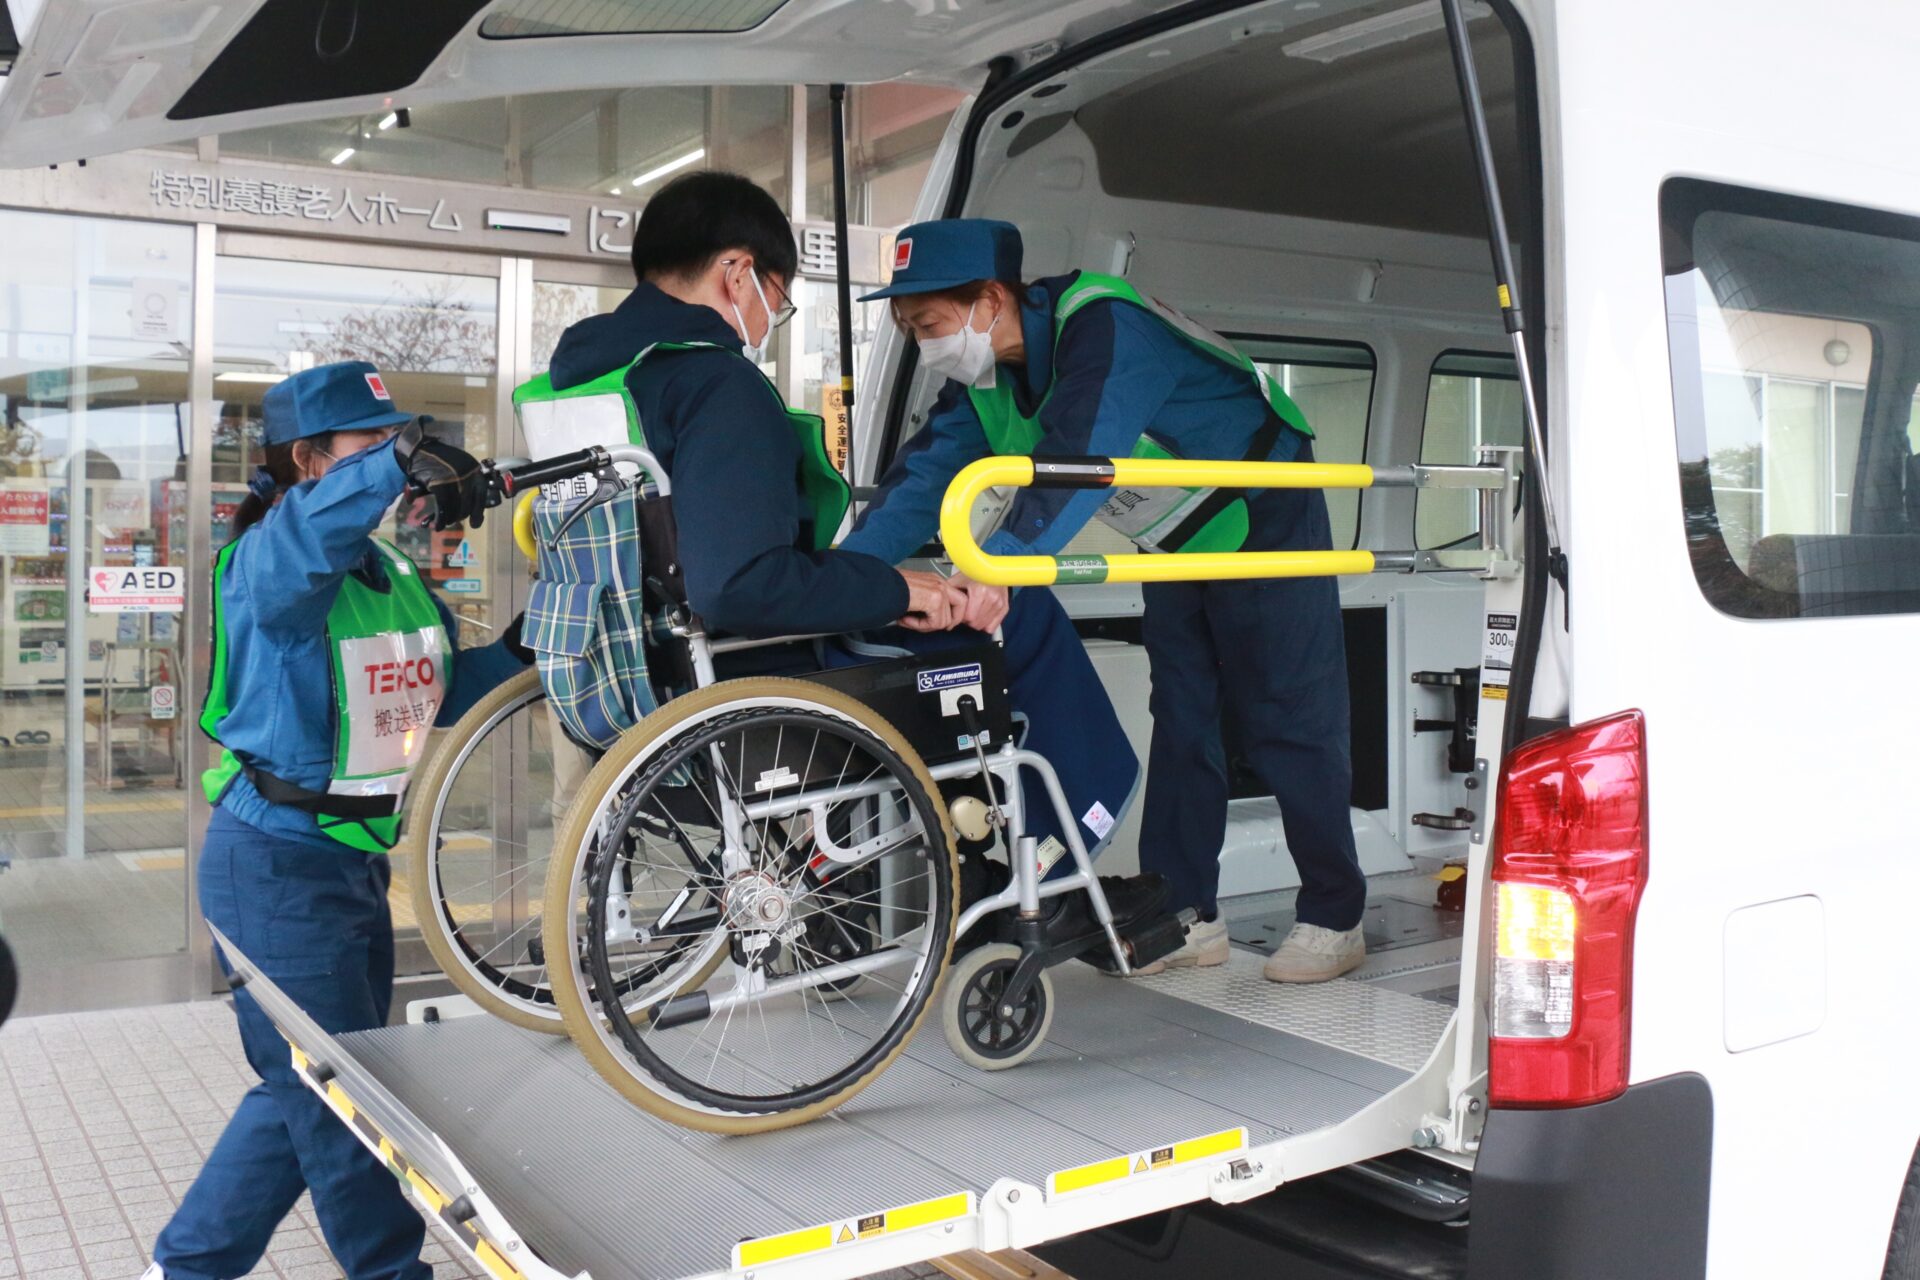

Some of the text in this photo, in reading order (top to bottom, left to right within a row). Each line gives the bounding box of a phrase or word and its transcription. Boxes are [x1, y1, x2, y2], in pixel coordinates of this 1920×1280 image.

[150, 168, 464, 233] 特別養護老人ホーム
[121, 572, 176, 589] AED
